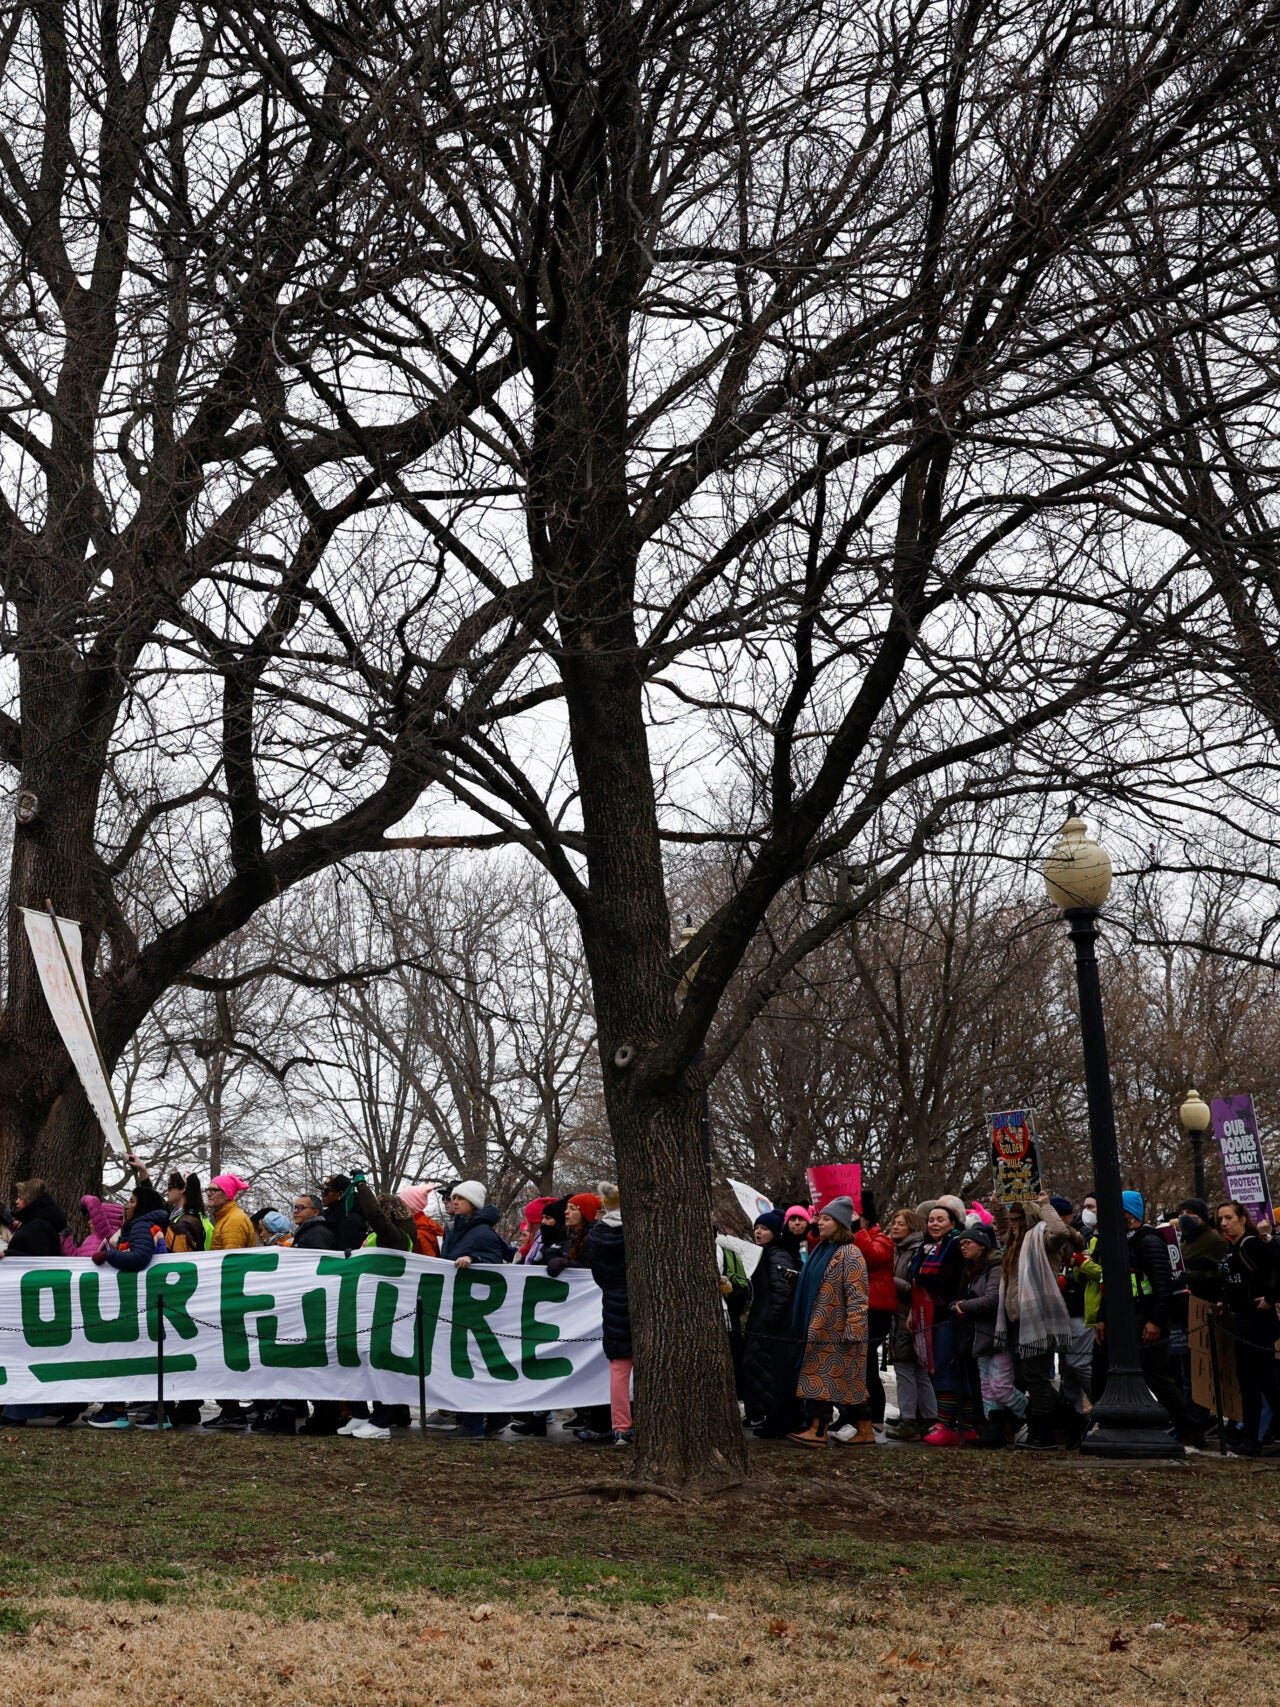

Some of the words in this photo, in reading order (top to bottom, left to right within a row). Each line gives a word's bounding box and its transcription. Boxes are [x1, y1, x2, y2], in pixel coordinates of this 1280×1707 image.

[1223, 1119, 1246, 1136] OUR
[1001, 1143, 1023, 1154] GOLDEN
[1221, 1135, 1256, 1154] BODIES
[1224, 1153, 1240, 1166] ARE
[1240, 1151, 1257, 1163] NOT
[1229, 1176, 1261, 1188] PROTECT
[1230, 1187, 1263, 1195] REPRODUCTIVE
[21, 1261, 199, 1347] OUR
[221, 1254, 574, 1381] FUTURE
